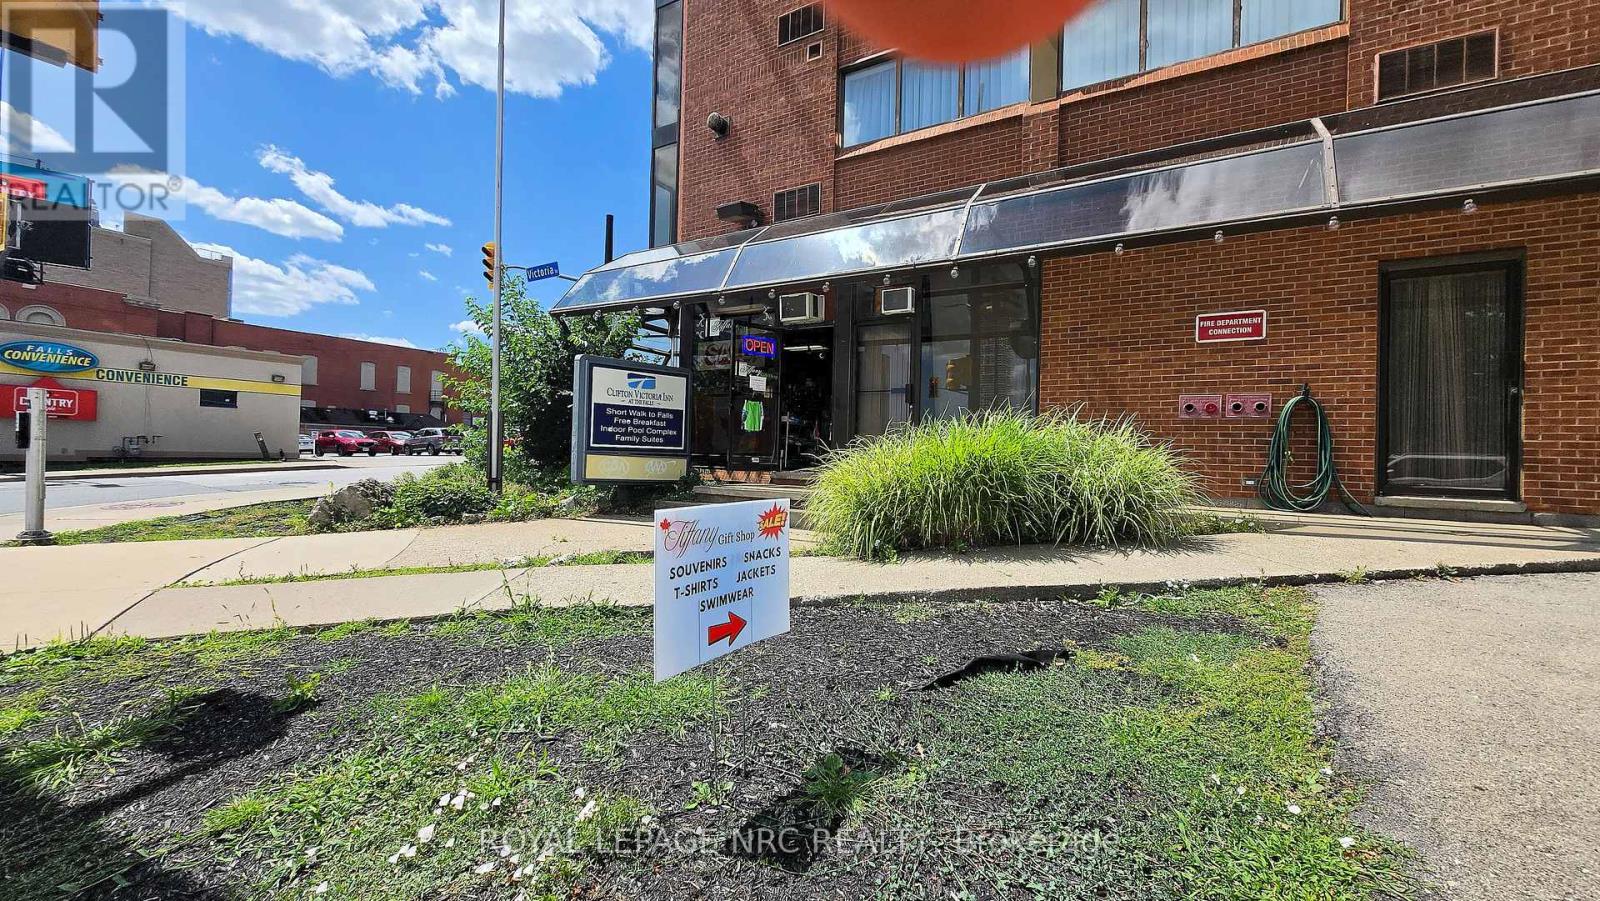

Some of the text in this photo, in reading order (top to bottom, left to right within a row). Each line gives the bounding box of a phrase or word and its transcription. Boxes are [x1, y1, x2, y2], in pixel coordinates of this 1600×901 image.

[527, 267, 554, 279] Victoria
[1217, 317, 1261, 326] DEPARTMENT
[1208, 327, 1252, 335] CONNECTION
[27, 345, 73, 355] FALLS
[745, 339, 774, 354] OPEN
[4, 350, 92, 366] CONVENIENCE
[95, 368, 188, 387] CONVENIENCE
[19, 396, 74, 408] CNTRY
[606, 408, 627, 416] Short
[633, 419, 666, 427] Breakfast
[600, 425, 626, 433] Indoor
[646, 428, 677, 436] Complex
[616, 435, 640, 443] Family
[664, 520, 755, 559] Tiffany Gift Shop
[669, 546, 781, 580] SOUVENIRS SNACKS
[674, 564, 776, 599] T-SHIRTS JACKETS
[699, 587, 754, 612] SWIMWEAR
